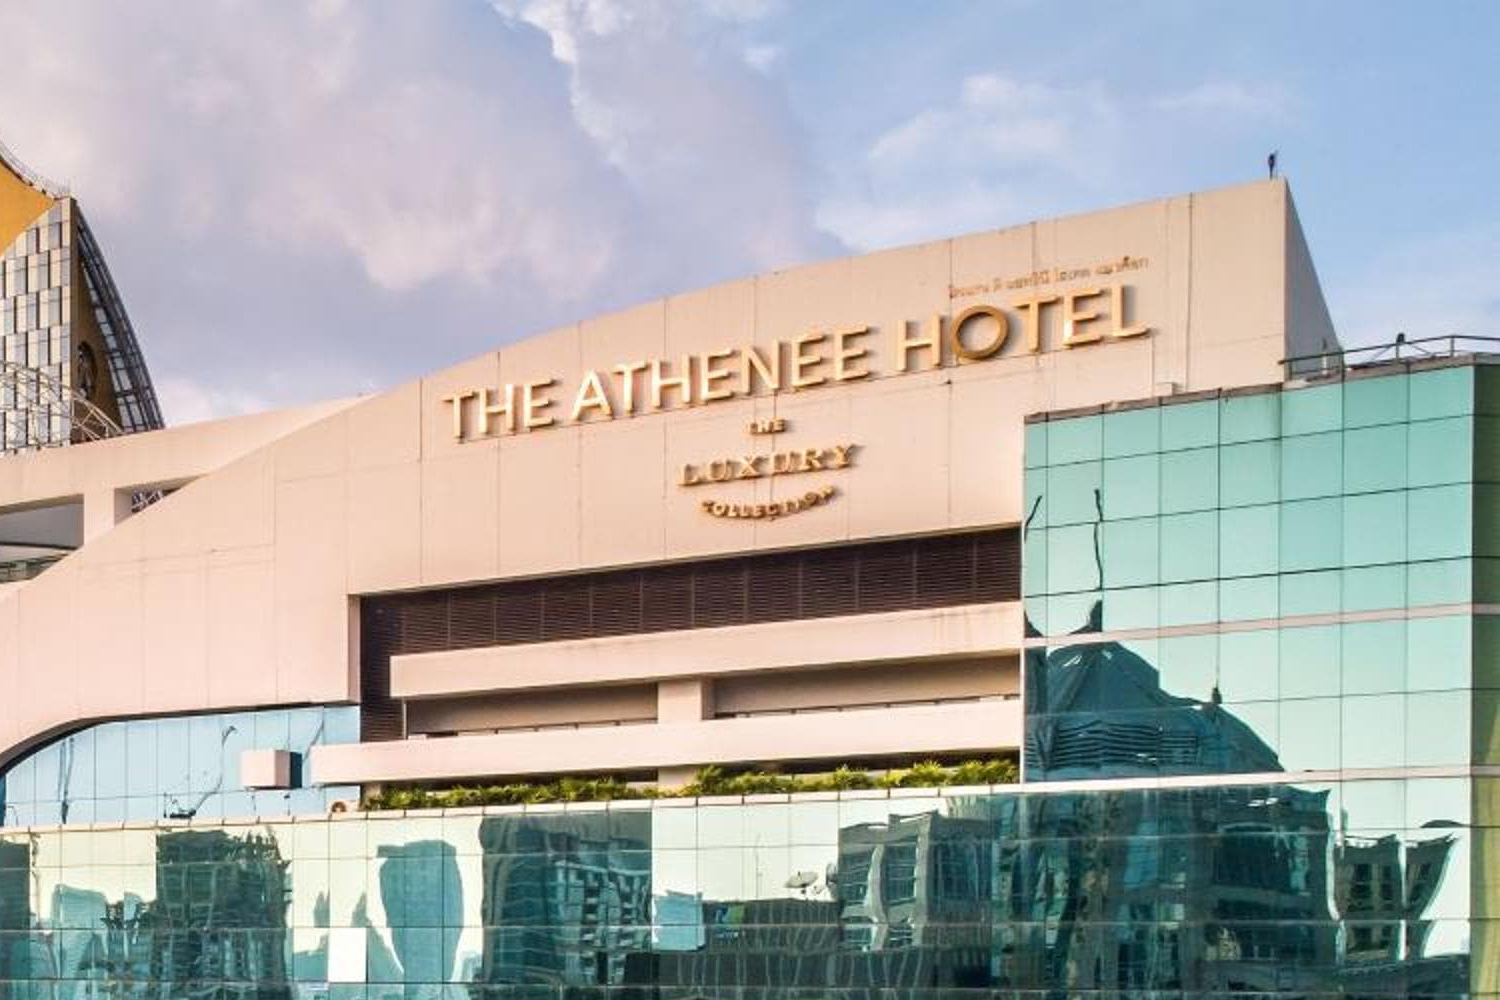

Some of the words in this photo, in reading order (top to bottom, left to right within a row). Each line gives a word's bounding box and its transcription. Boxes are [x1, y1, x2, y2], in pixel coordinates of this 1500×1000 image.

[443, 378, 555, 442] THE
[896, 284, 1151, 372] HOTEL
[743, 418, 788, 435] THE
[677, 444, 858, 486] LUXURY
[700, 485, 837, 521] COLLECTION
